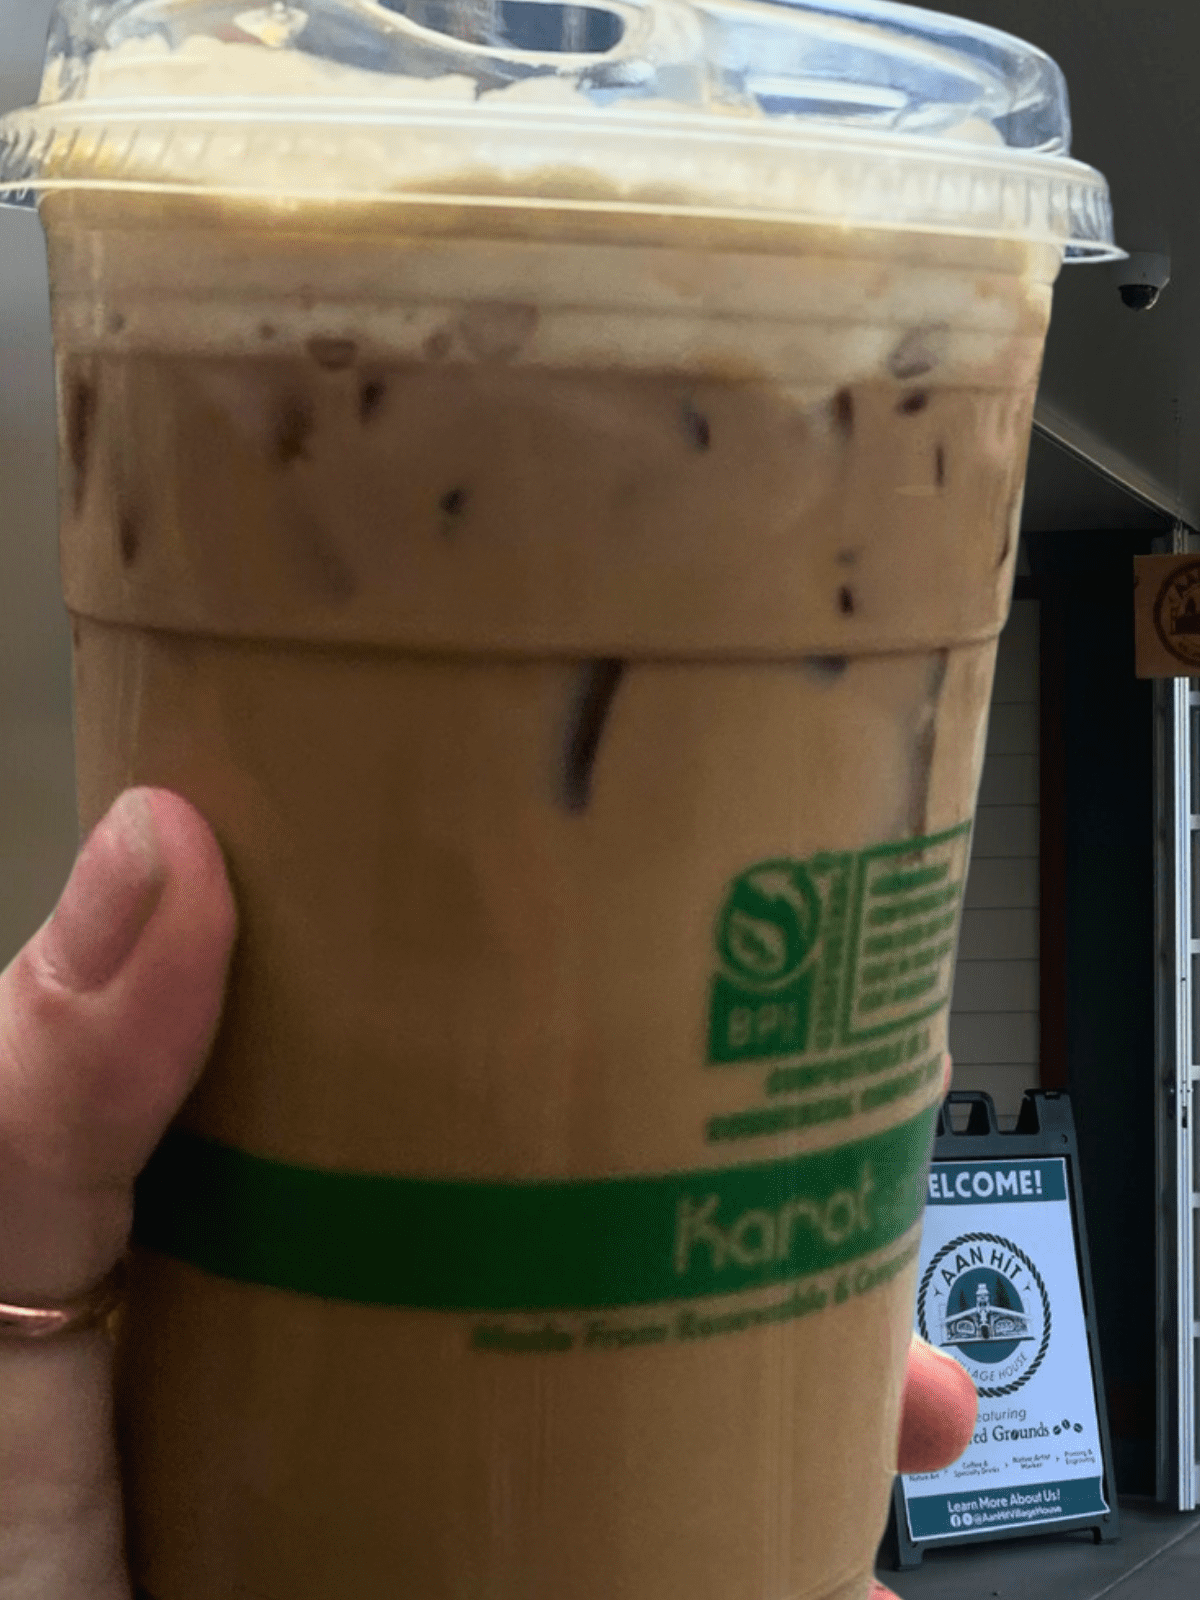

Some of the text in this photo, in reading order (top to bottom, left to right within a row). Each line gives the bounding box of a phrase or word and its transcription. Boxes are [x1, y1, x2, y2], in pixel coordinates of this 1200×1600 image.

[927, 1169, 1043, 1198] ELCOME!
[941, 1246, 984, 1286] AAN
[998, 1351, 1028, 1380] HOUSE
[977, 1408, 1027, 1423] eaturing
[992, 1421, 1050, 1442] Grounds
[947, 1488, 1061, 1514] Learn More About Us!
